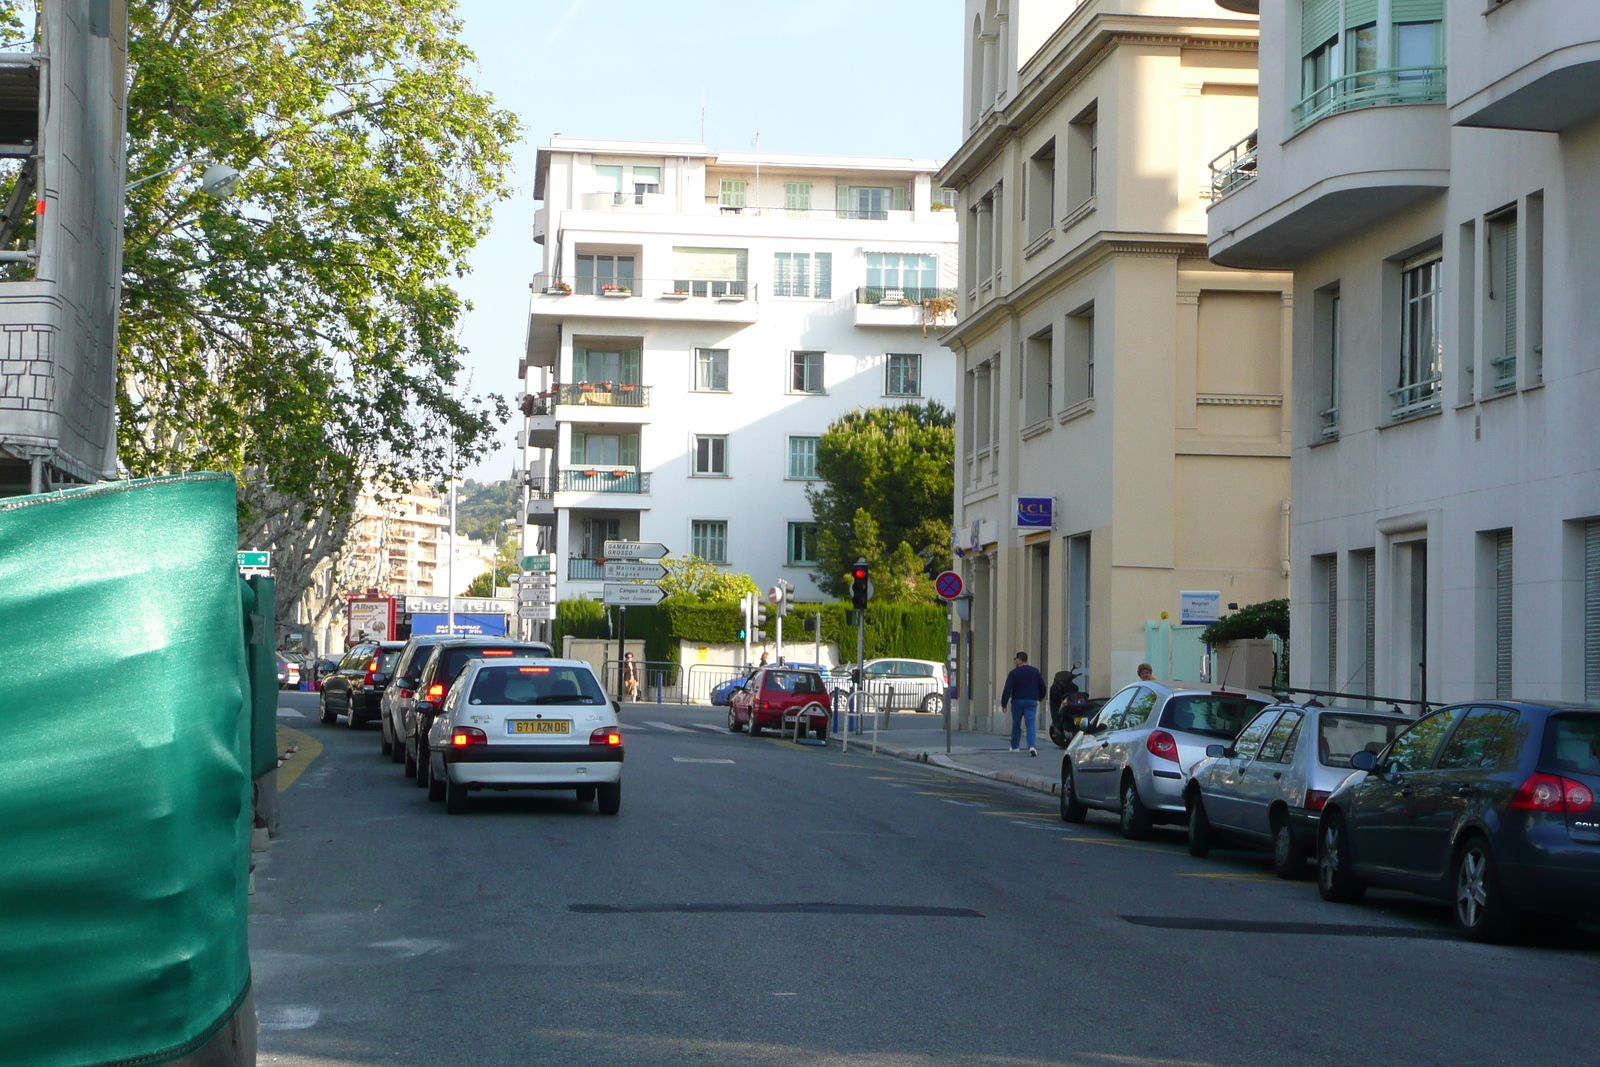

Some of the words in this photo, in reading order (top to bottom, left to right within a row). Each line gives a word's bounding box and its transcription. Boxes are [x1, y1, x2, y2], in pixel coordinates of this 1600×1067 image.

[1020, 503, 1048, 513] LCL
[517, 722, 534, 732] 671
[537, 722, 553, 732] AZN
[554, 722, 567, 732] 06
